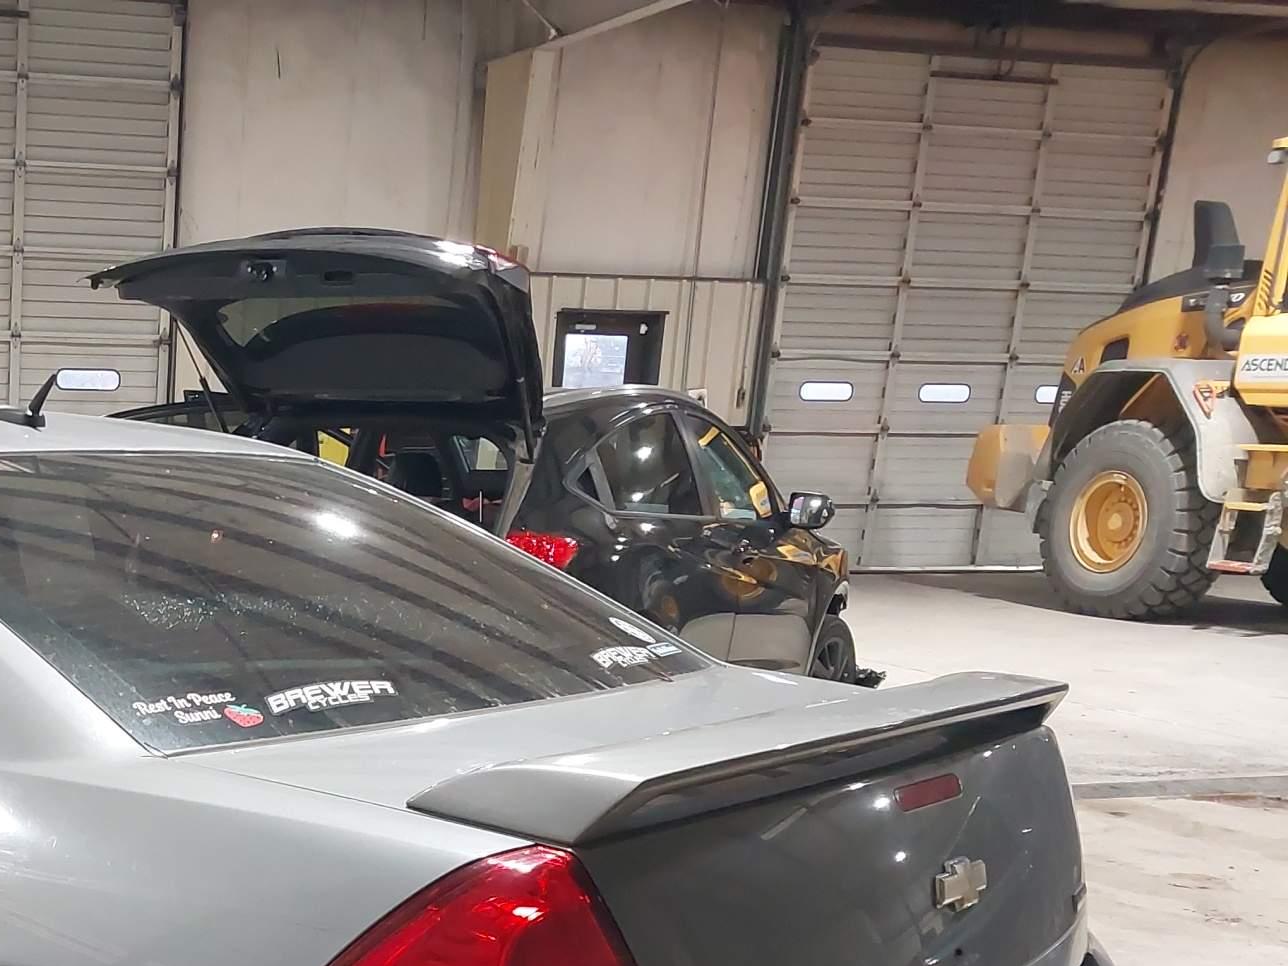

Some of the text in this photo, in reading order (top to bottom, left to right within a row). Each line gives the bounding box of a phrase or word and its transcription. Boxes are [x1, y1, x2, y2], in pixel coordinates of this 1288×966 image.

[591, 646, 656, 668] BREWER
[133, 690, 237, 716] Rest In Peace
[268, 680, 396, 714] BREWER
[307, 692, 372, 712] CYCLES
[175, 707, 222, 724] Sunni
